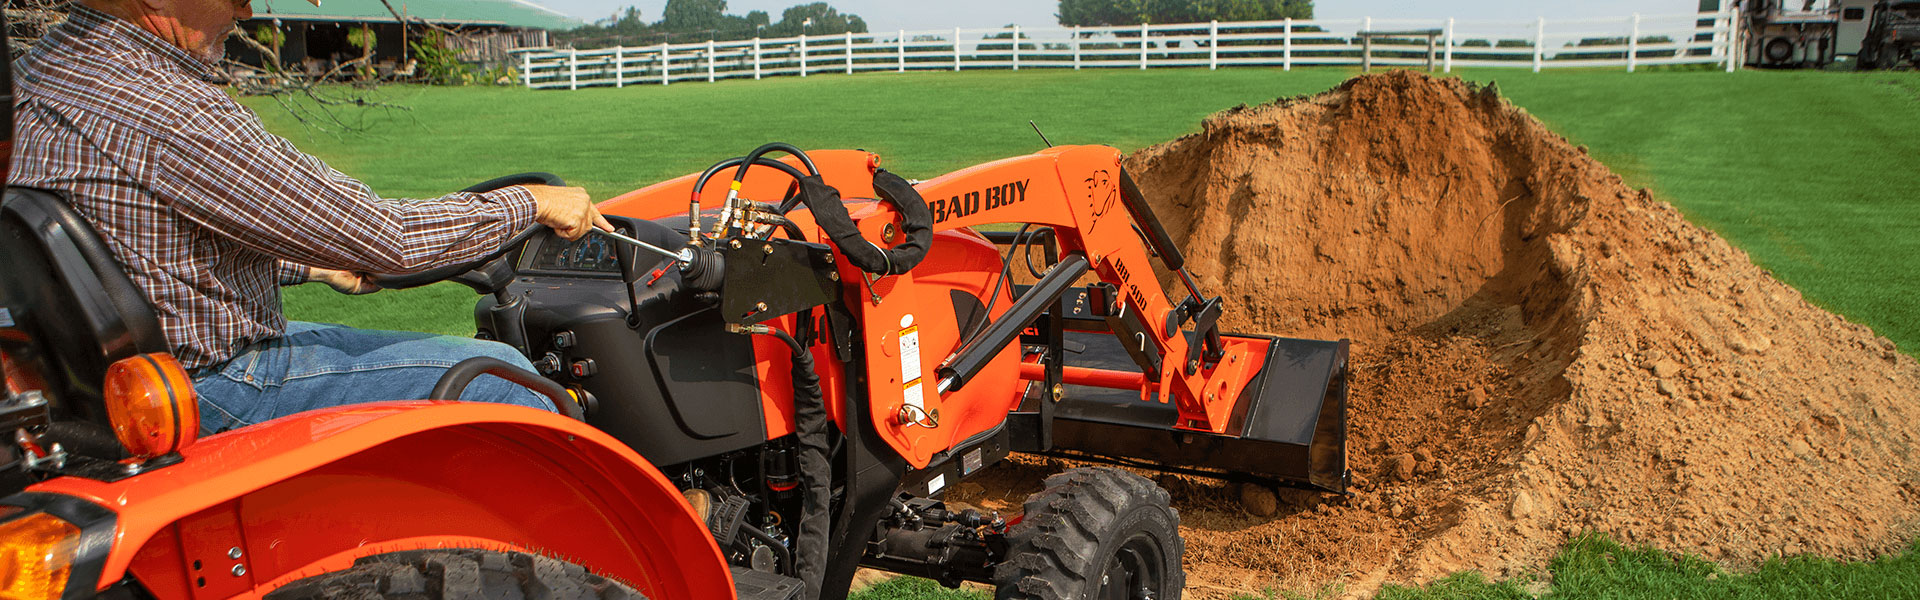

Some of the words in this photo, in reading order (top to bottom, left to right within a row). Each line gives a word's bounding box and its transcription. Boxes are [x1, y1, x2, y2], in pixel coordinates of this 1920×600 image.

[928, 191, 980, 224] BAD
[985, 178, 1030, 211] BOY
[1115, 257, 1130, 287] BBL
[1130, 284, 1147, 311] 400
